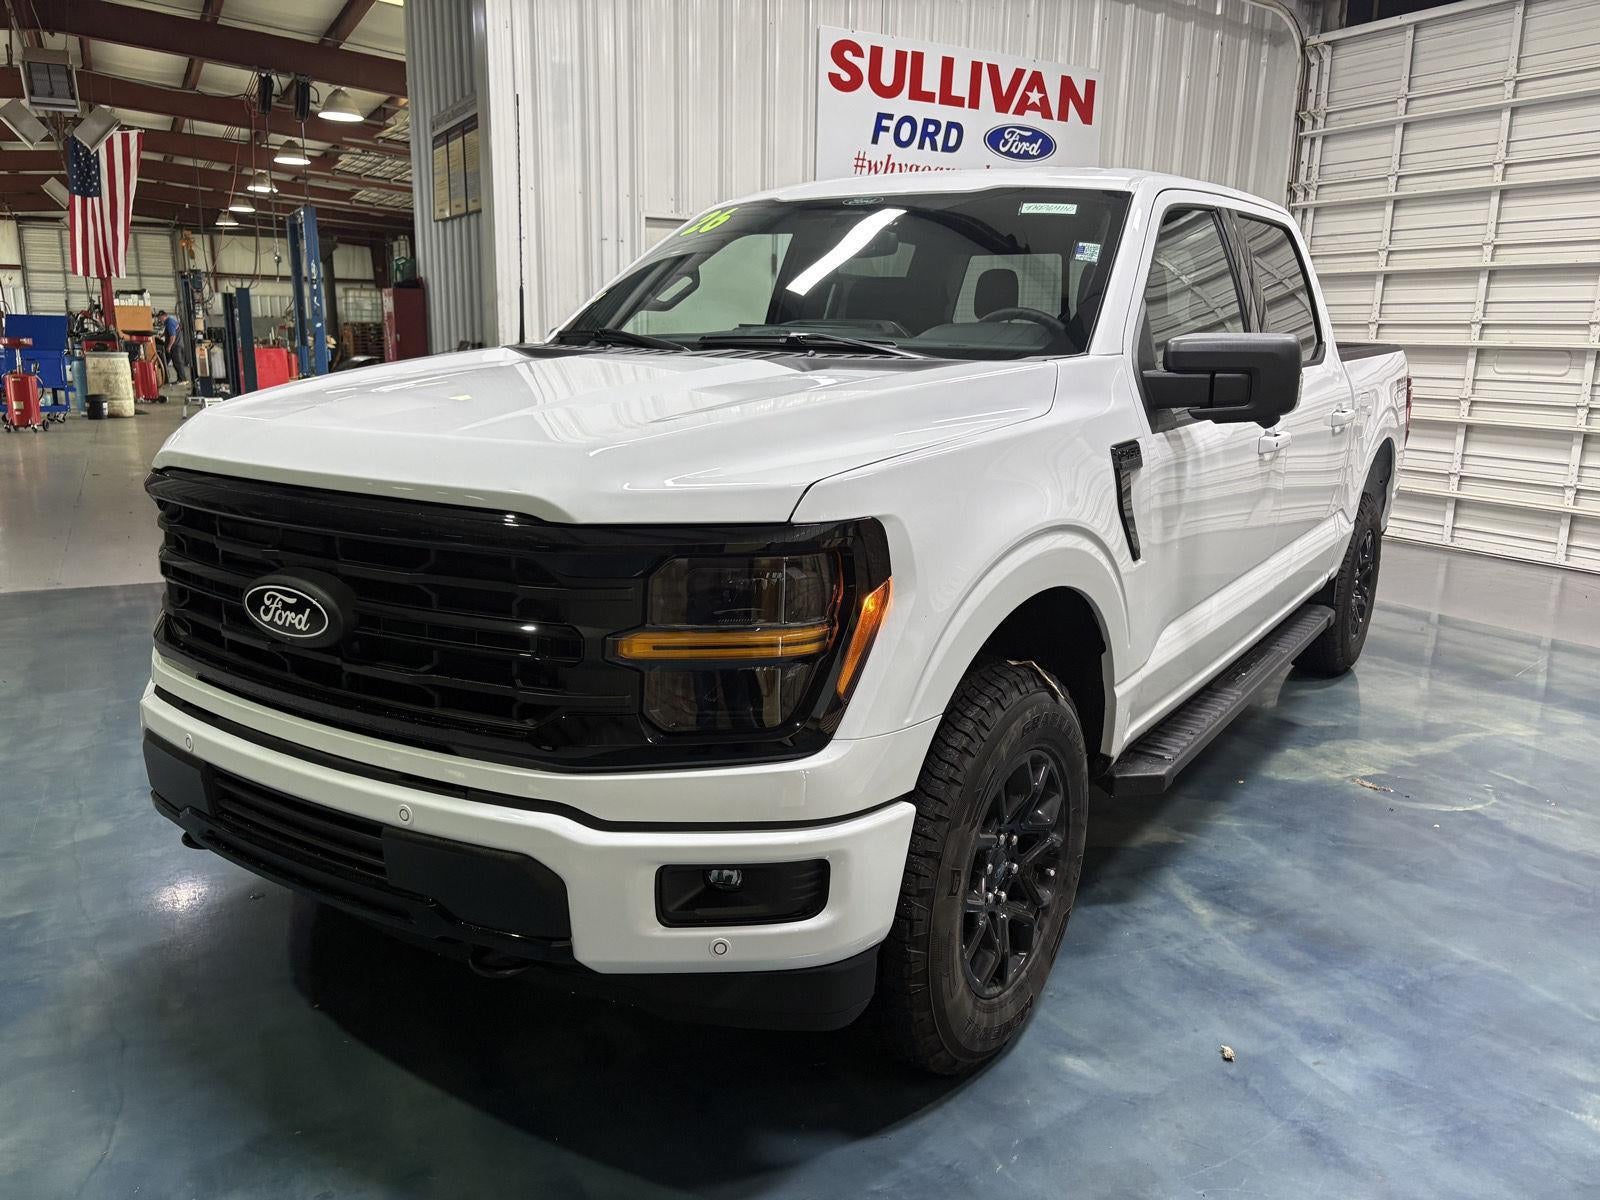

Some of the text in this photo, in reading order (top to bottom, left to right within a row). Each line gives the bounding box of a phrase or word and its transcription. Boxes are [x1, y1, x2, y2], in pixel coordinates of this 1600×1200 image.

[827, 38, 1096, 126] SULLIVAN
[870, 111, 965, 154] FORD
[998, 127, 1043, 156] Ford
[679, 206, 738, 237] 26
[260, 591, 311, 632] Ford
